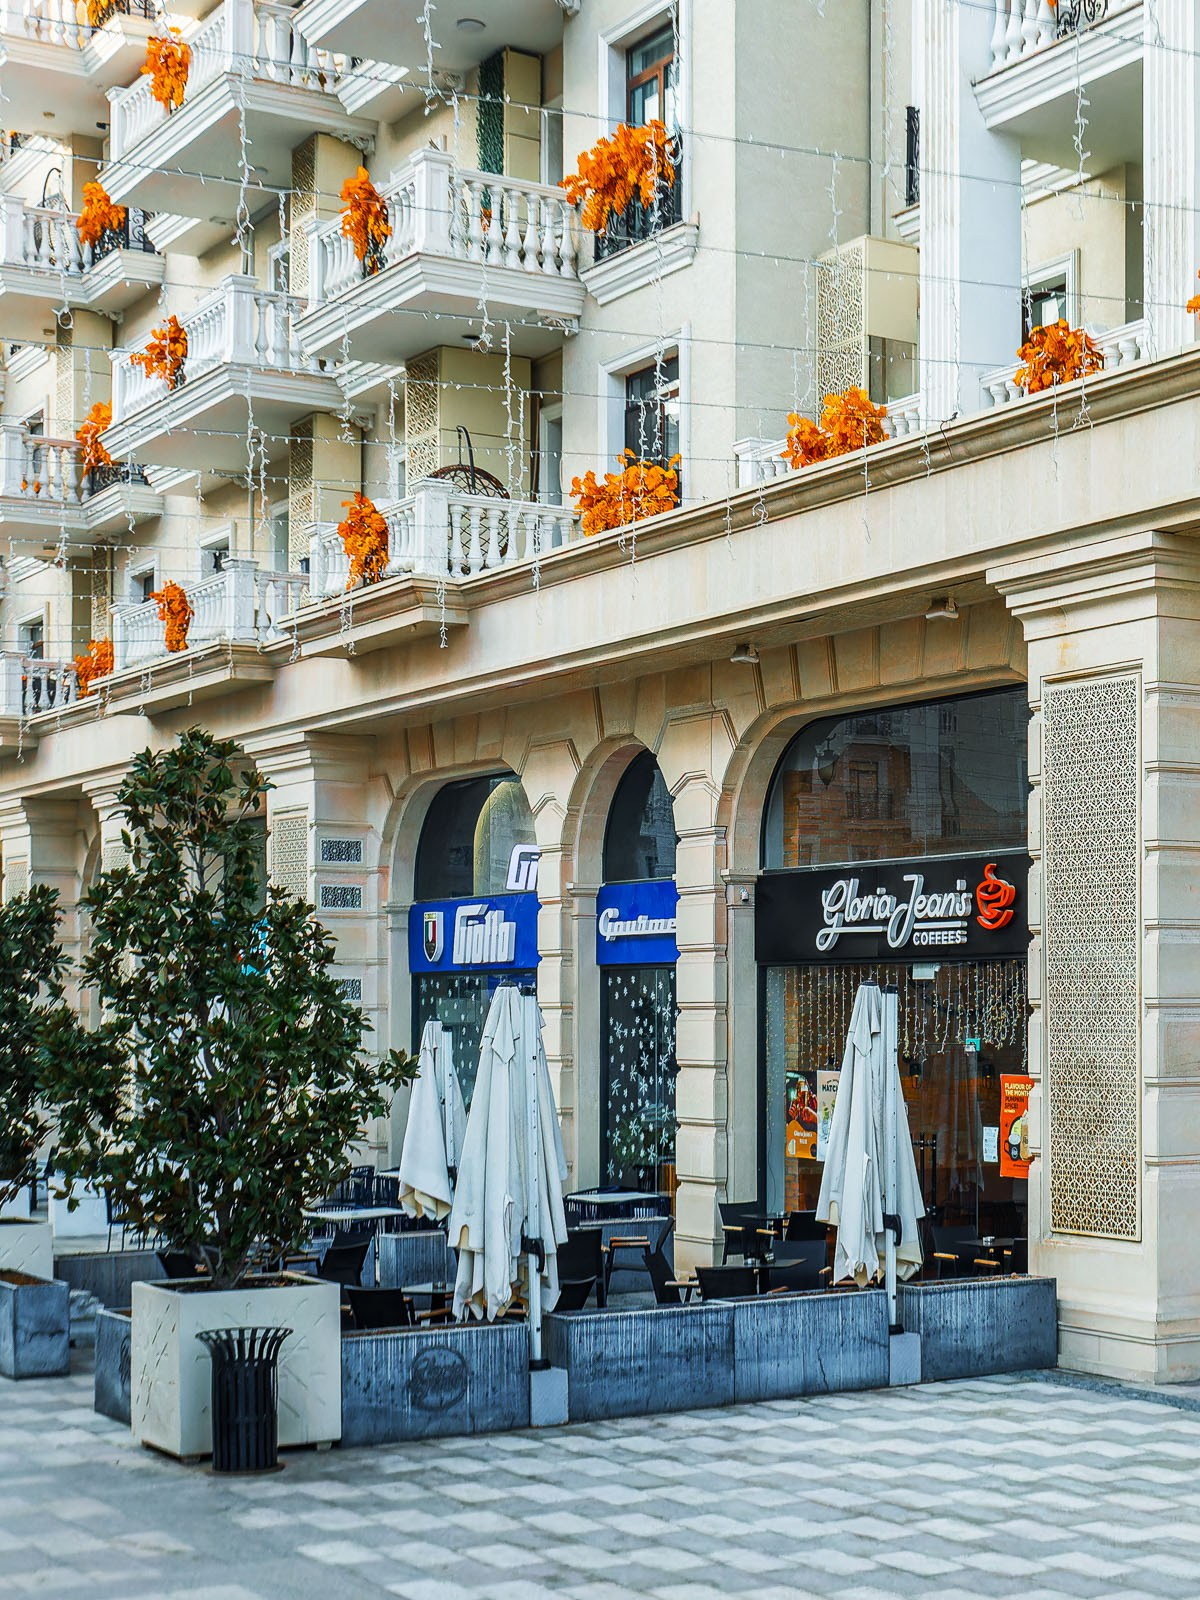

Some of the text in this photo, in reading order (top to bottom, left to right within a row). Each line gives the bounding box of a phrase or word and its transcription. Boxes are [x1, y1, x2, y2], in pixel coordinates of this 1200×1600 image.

[816, 874, 973, 951] Gloria Jean's
[912, 929, 968, 946] COFFEES
